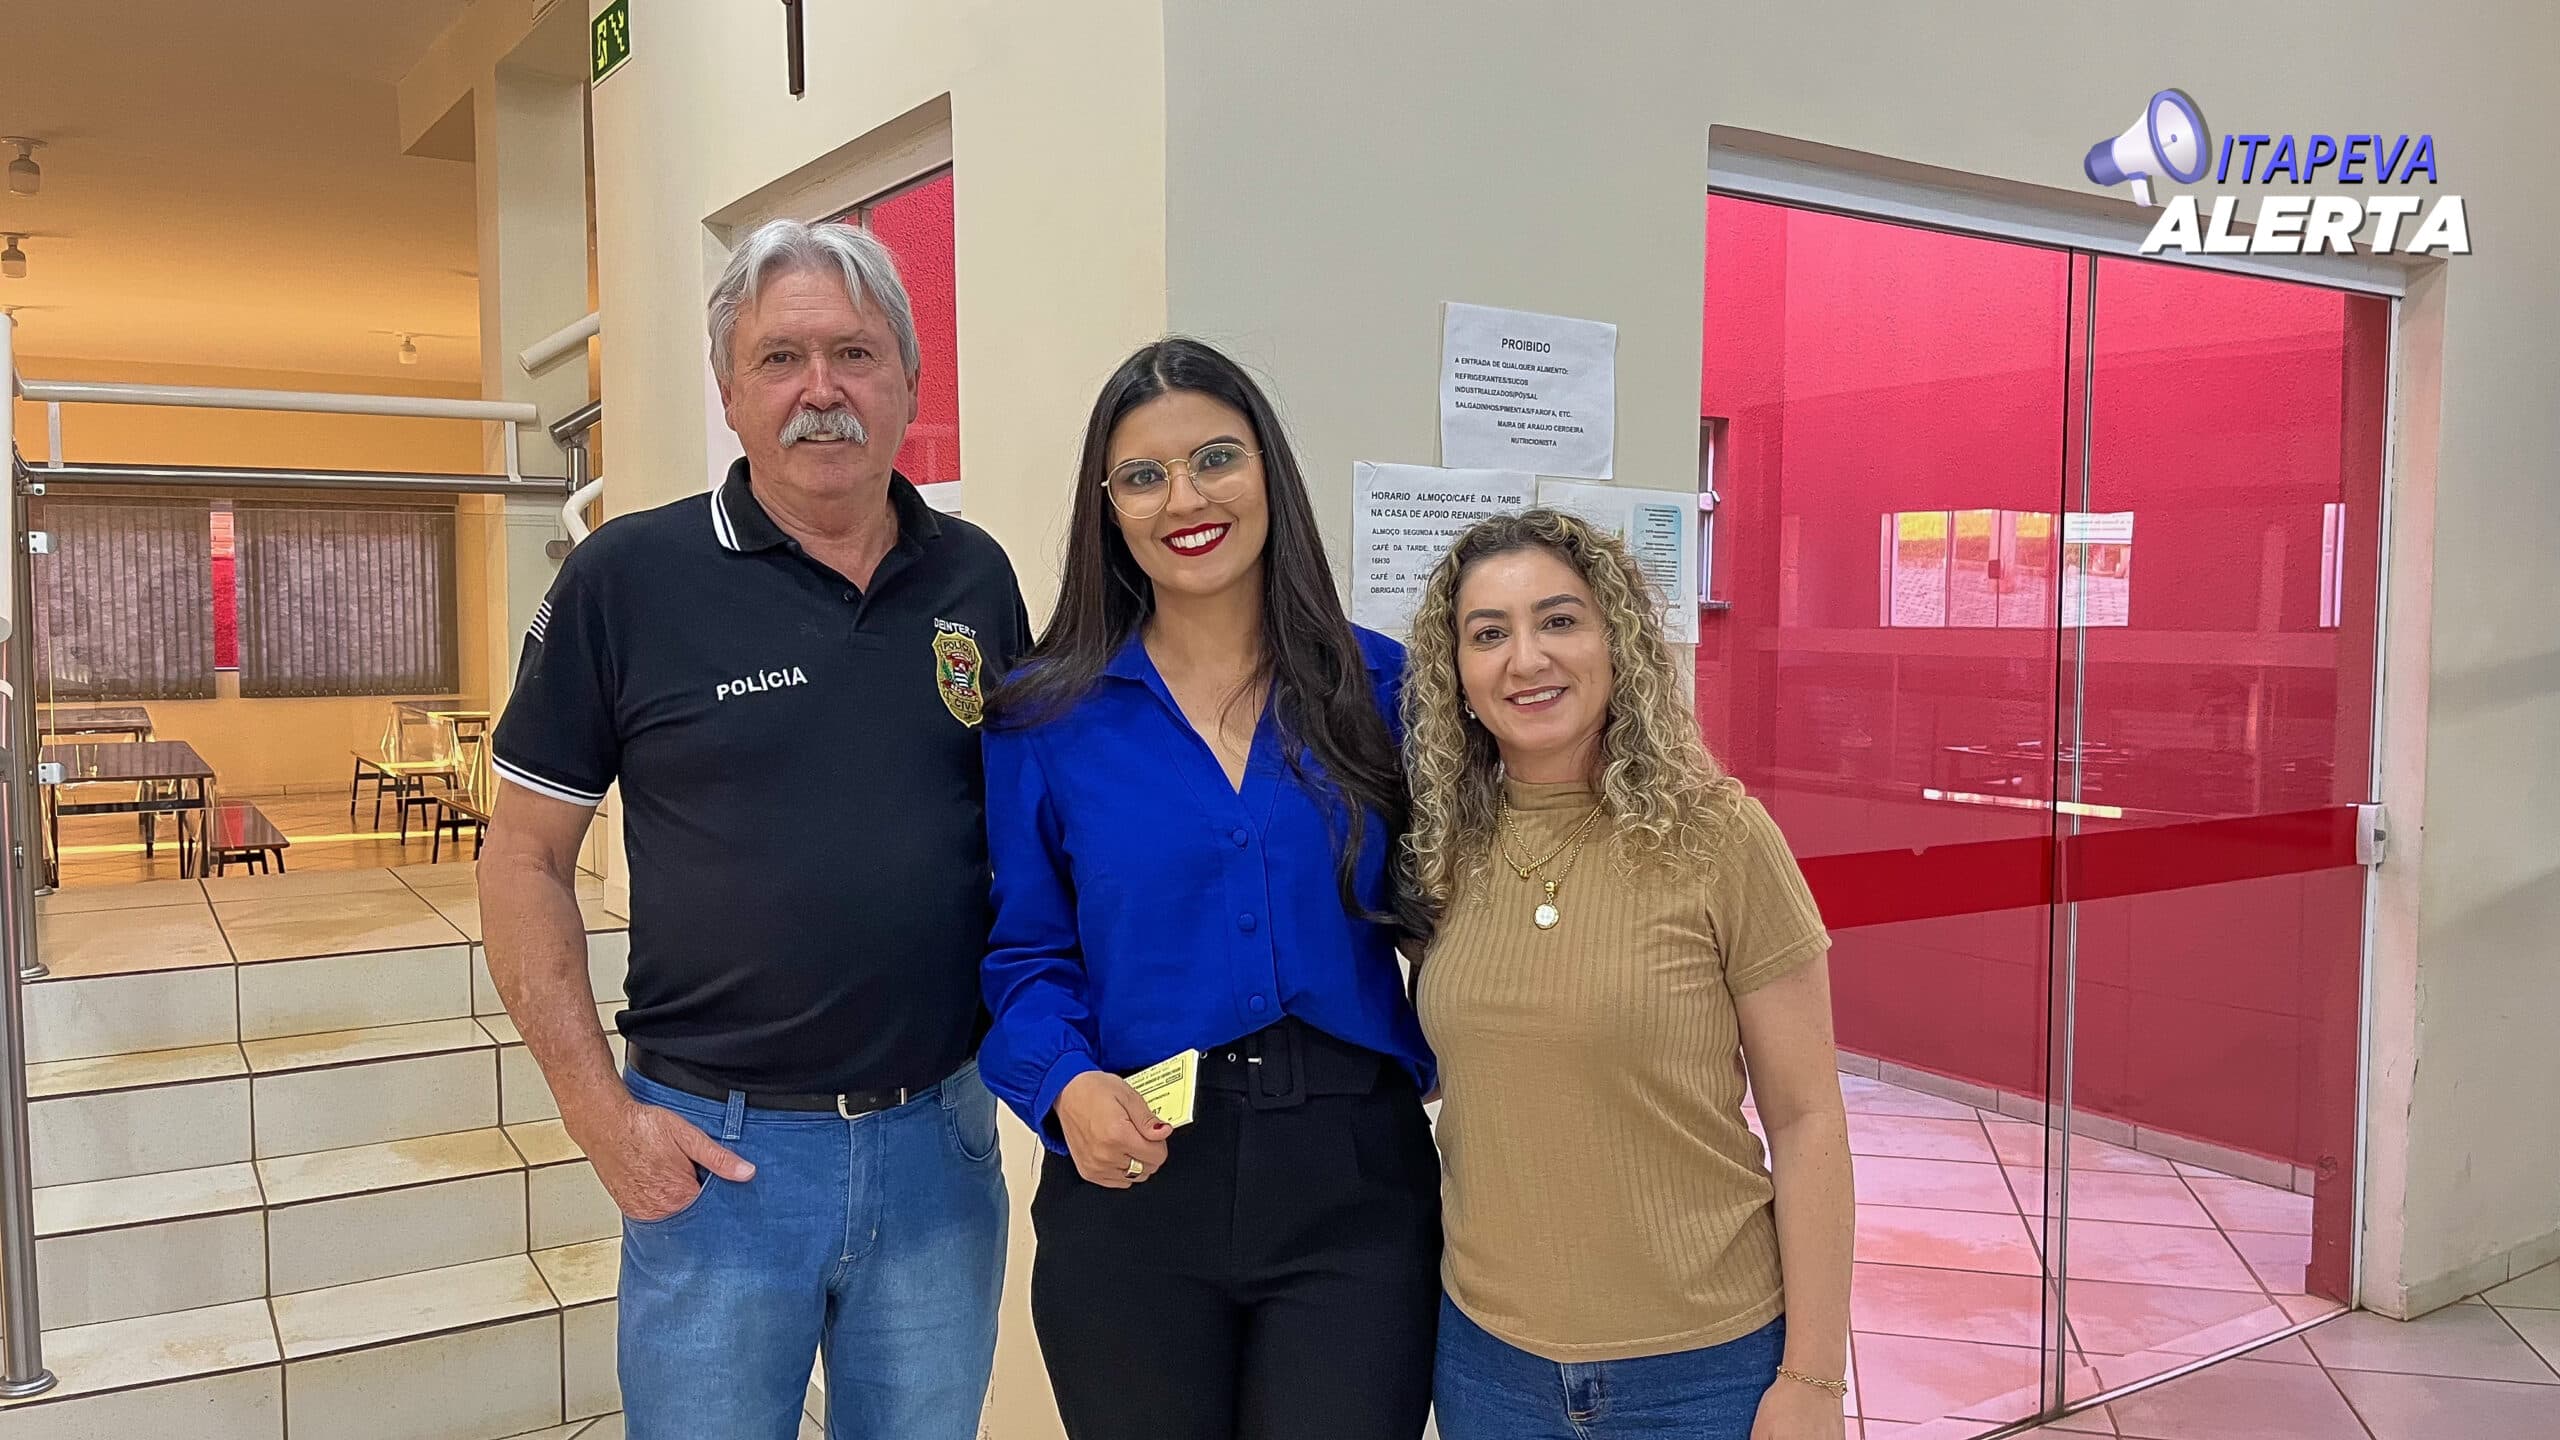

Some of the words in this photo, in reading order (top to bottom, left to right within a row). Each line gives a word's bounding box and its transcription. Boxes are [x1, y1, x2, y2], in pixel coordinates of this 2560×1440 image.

[1501, 338, 1551, 353] PROIBIDO
[1461, 358, 1491, 367] ENTRADA
[1501, 362, 1536, 372] QUALQUER
[1455, 373, 1529, 386] REFRIGERANTES/SUCOS
[1510, 437, 1557, 447] NUTRICIONISTA
[1371, 491, 1411, 501] HORARIO
[1481, 495, 1491, 503] DA
[1497, 496, 1521, 504] TARDE
[1371, 509, 1383, 517] NA
[1384, 509, 1408, 518] CASA
[1409, 510, 1421, 518] DE
[1422, 510, 1449, 519] APOIO
[1371, 528, 1400, 536] ALMOÇO
[1371, 543, 1389, 551] CAFÉ
[1371, 557, 1391, 565] 16H30
[1370, 573, 1388, 581] CAFÉ
[716, 667, 808, 701] POLÍCIA
